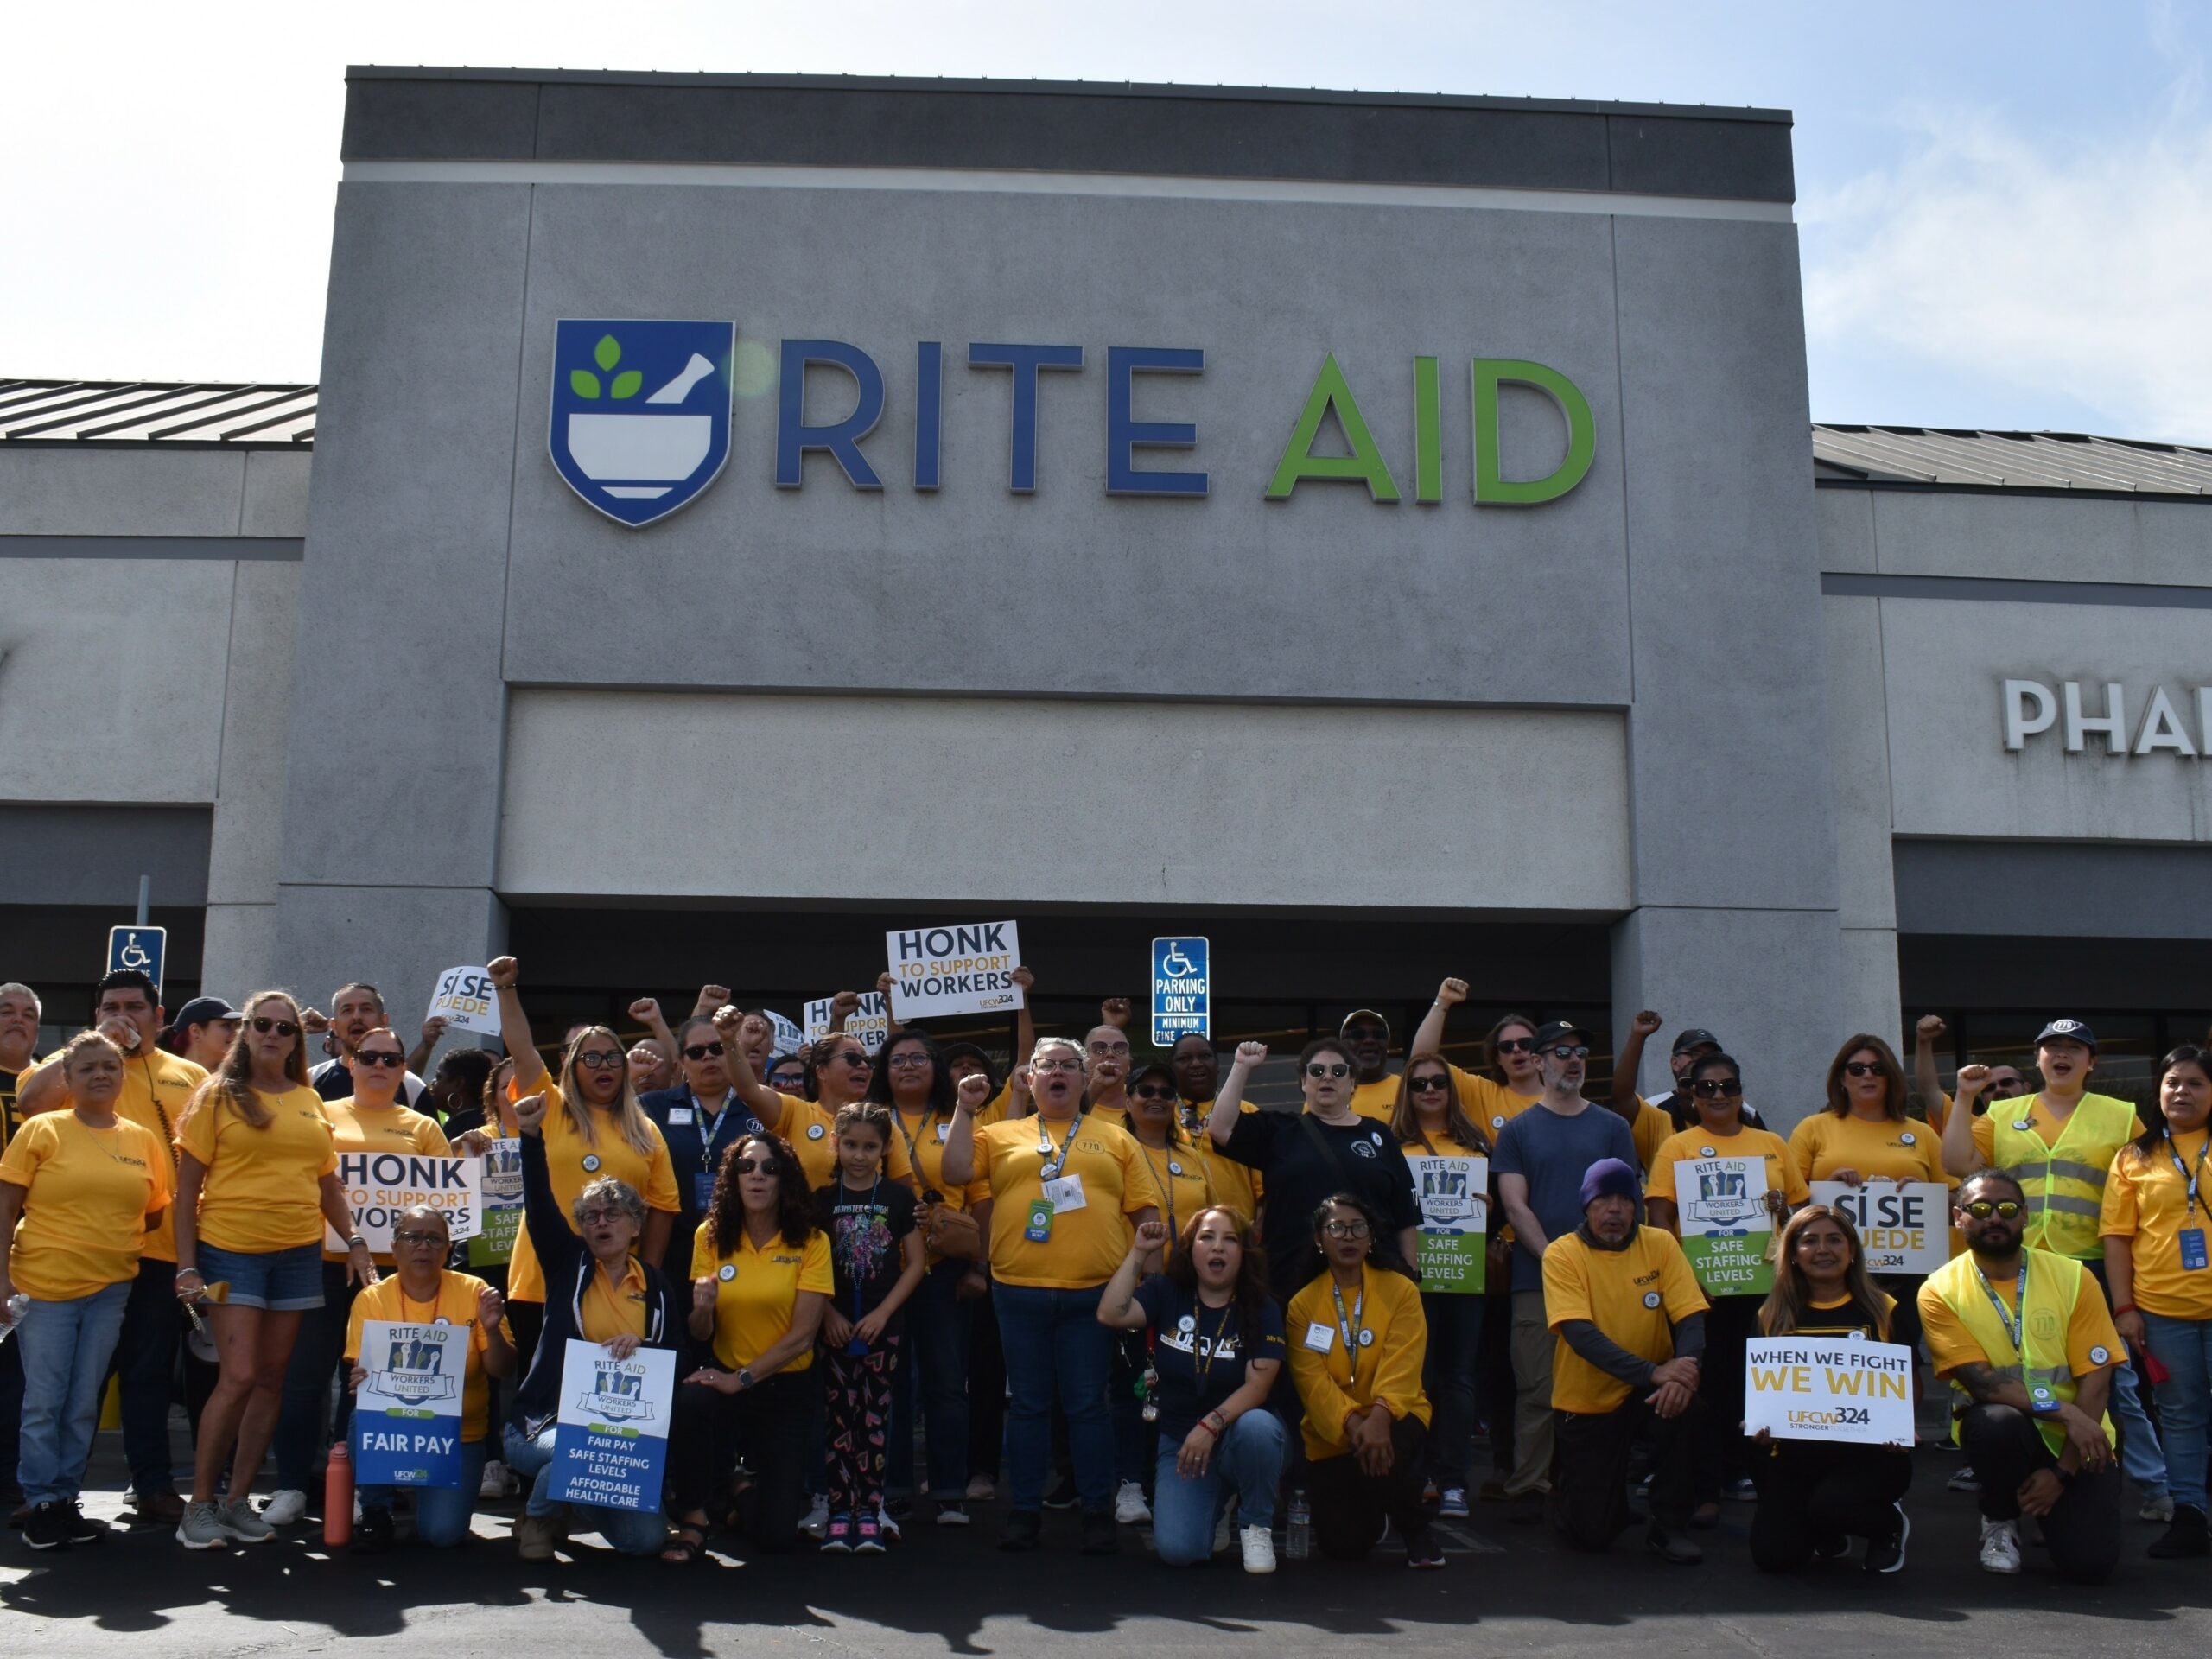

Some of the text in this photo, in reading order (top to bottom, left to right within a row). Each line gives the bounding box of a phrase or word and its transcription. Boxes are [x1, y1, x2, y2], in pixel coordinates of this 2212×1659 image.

[774, 338, 1597, 506] RITE AID
[899, 923, 1008, 960] HONK
[899, 954, 1011, 977] TO SUPPORT
[439, 969, 492, 1001] SÍ SE
[900, 970, 1013, 998] WORKERS
[1156, 978, 1205, 995] PARKING
[435, 995, 490, 1016] PUEDE
[811, 993, 887, 1023] HNK
[1165, 995, 1196, 1012] ONLY
[843, 1017, 887, 1033] UPPOR
[1162, 1017, 1199, 1028] MINIMUM
[1156, 1030, 1175, 1041] FINE
[1082, 1141, 1100, 1151] 770
[340, 1154, 468, 1189] HONK
[1420, 1160, 1470, 1172] RITE AID
[1694, 1160, 1746, 1174] RITE AID
[375, 1189, 471, 1208] SUPPORT
[1426, 1198, 1464, 1207] WORKERS
[1705, 1199, 1744, 1209] WORKERS
[832, 1205, 864, 1214] MONSTER
[1709, 1208, 1741, 1217] UNITED
[1834, 1185, 1925, 1229] SÍ SE
[494, 1212, 523, 1225] SAF
[480, 1226, 518, 1240] STAFF
[490, 1239, 516, 1252] LEV
[1427, 1238, 1459, 1250] SAFE
[1711, 1240, 1744, 1253] SAFE
[1696, 1254, 1762, 1269] STAFFING
[1421, 1266, 1465, 1280] LEVELS
[1706, 1268, 1754, 1283] LEVELS
[2034, 1316, 2055, 1332] 770
[389, 1327, 448, 1343] RITE AID
[594, 1360, 646, 1375] RITE AID
[1750, 1351, 1907, 1372] WHEN WE FIGHT
[391, 1374, 435, 1384] WORKERS
[1751, 1366, 1906, 1400] WE WIN
[394, 1383, 430, 1394] UNITED
[597, 1395, 637, 1408] WORKERS
[601, 1403, 632, 1414] UNITED
[402, 1408, 420, 1417] FOR
[605, 1425, 623, 1434] FOR
[363, 1432, 454, 1455] FAIR PAY
[588, 1435, 636, 1452] FAIR PAY
[569, 1447, 650, 1469] SAFE STAFFING
[588, 1463, 626, 1478] LEVELS
[569, 1476, 641, 1496] AFFORDABLE
[565, 1487, 639, 1508] HEALTH CARE
